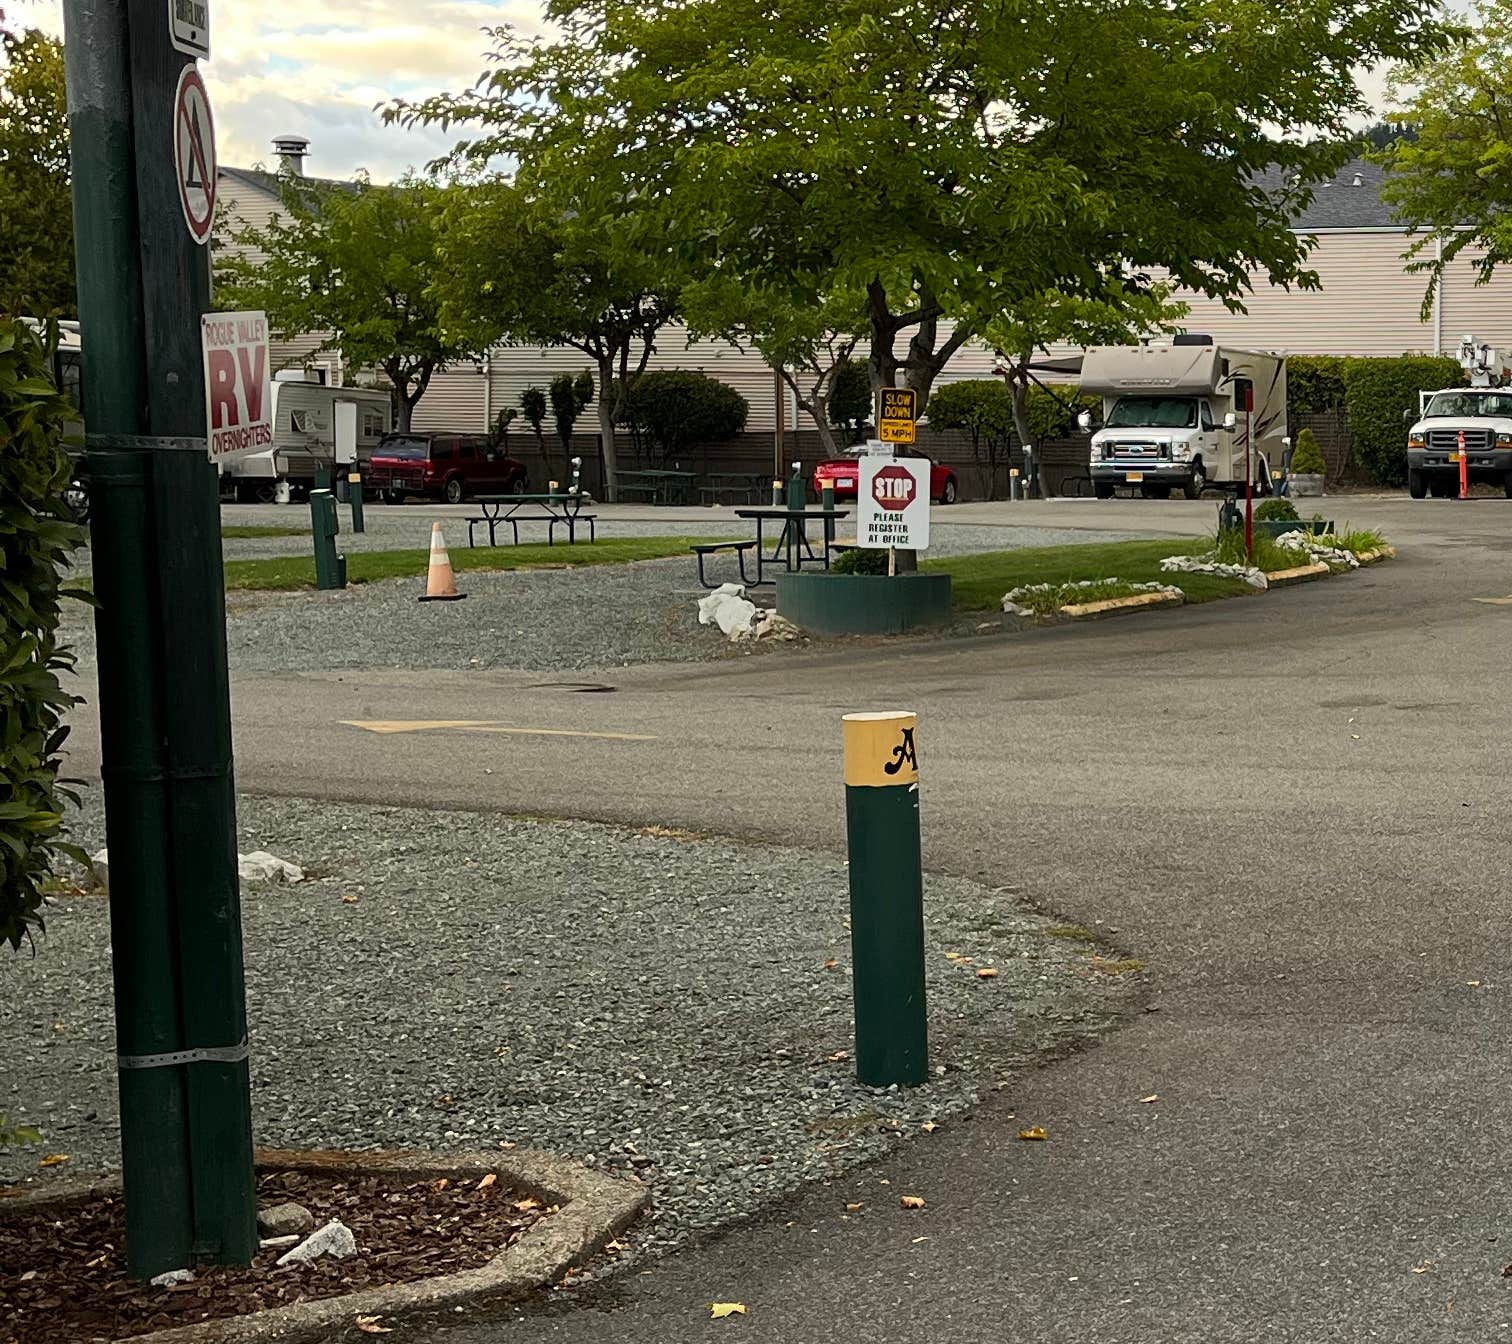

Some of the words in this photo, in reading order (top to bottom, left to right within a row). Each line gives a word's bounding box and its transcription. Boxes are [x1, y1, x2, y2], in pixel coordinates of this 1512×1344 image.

[205, 322, 235, 346] ROGUE
[236, 319, 265, 344] VALLEY
[207, 345, 266, 430] RV
[885, 393, 911, 406] SLOW
[884, 406, 911, 418] DOWN
[211, 422, 272, 455] OVERNIGHTERS
[882, 427, 889, 438] 5
[891, 429, 912, 438] MPH
[875, 477, 913, 499] STOP
[873, 513, 904, 522] PLEASE
[868, 523, 909, 533] REGISTER
[868, 534, 878, 543] AT
[882, 534, 909, 544] OFFICE
[883, 726, 919, 775] A
